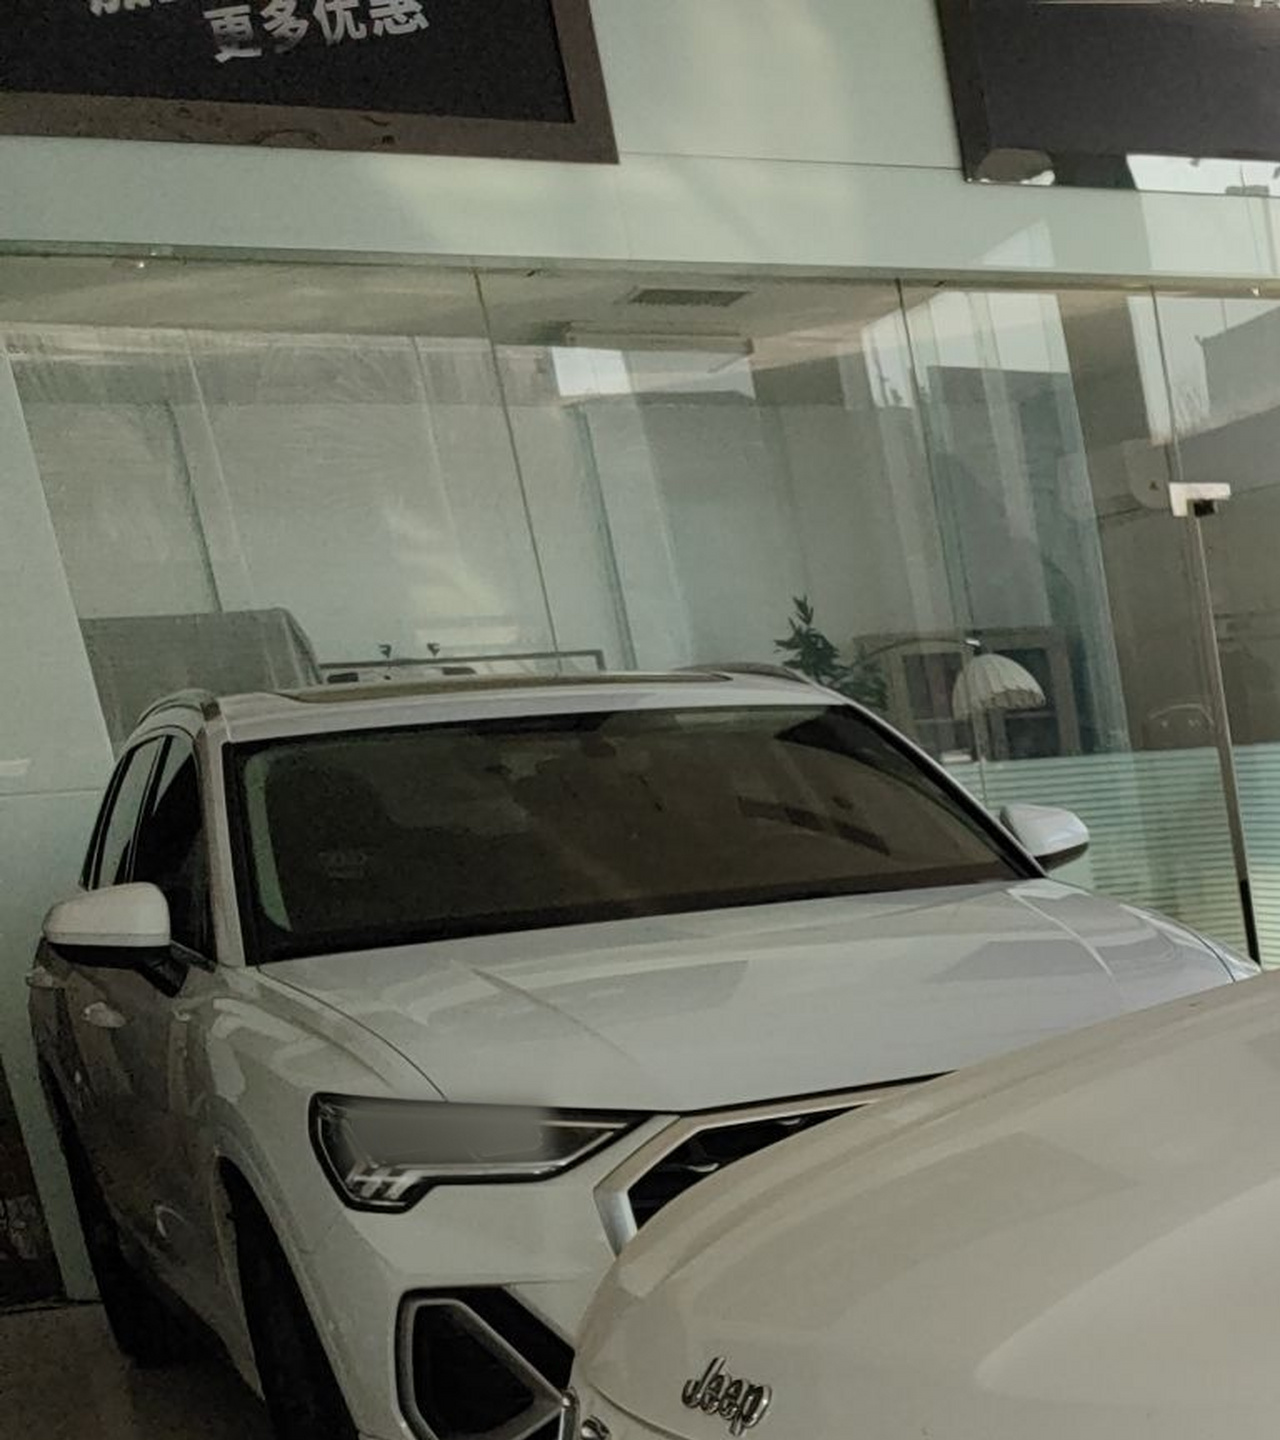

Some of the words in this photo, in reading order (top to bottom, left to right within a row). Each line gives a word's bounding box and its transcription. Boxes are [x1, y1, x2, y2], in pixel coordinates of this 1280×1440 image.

[203, 0, 430, 63] 更多优惠
[681, 1357, 772, 1437] Jeep
